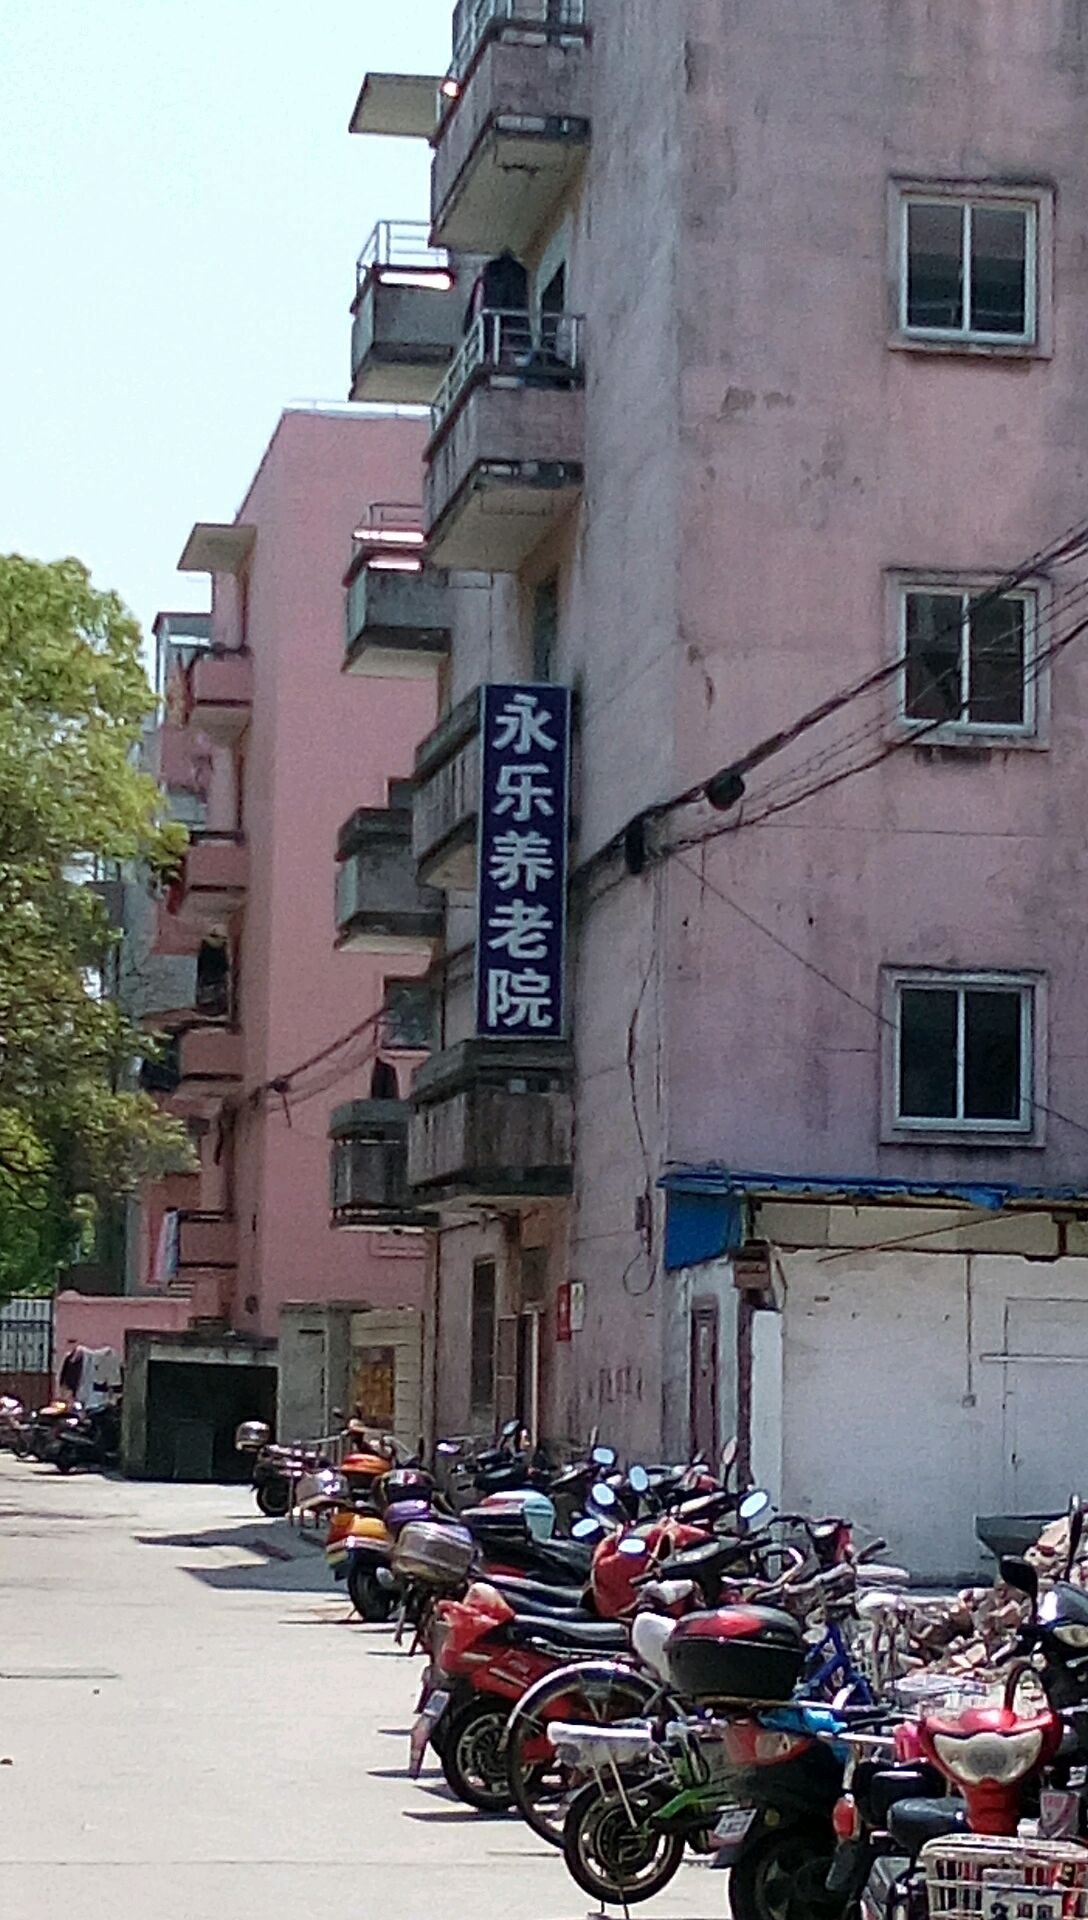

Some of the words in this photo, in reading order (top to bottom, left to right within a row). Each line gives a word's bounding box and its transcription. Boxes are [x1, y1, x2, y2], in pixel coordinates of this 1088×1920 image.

[487, 693, 558, 1028] 永乐养老院
